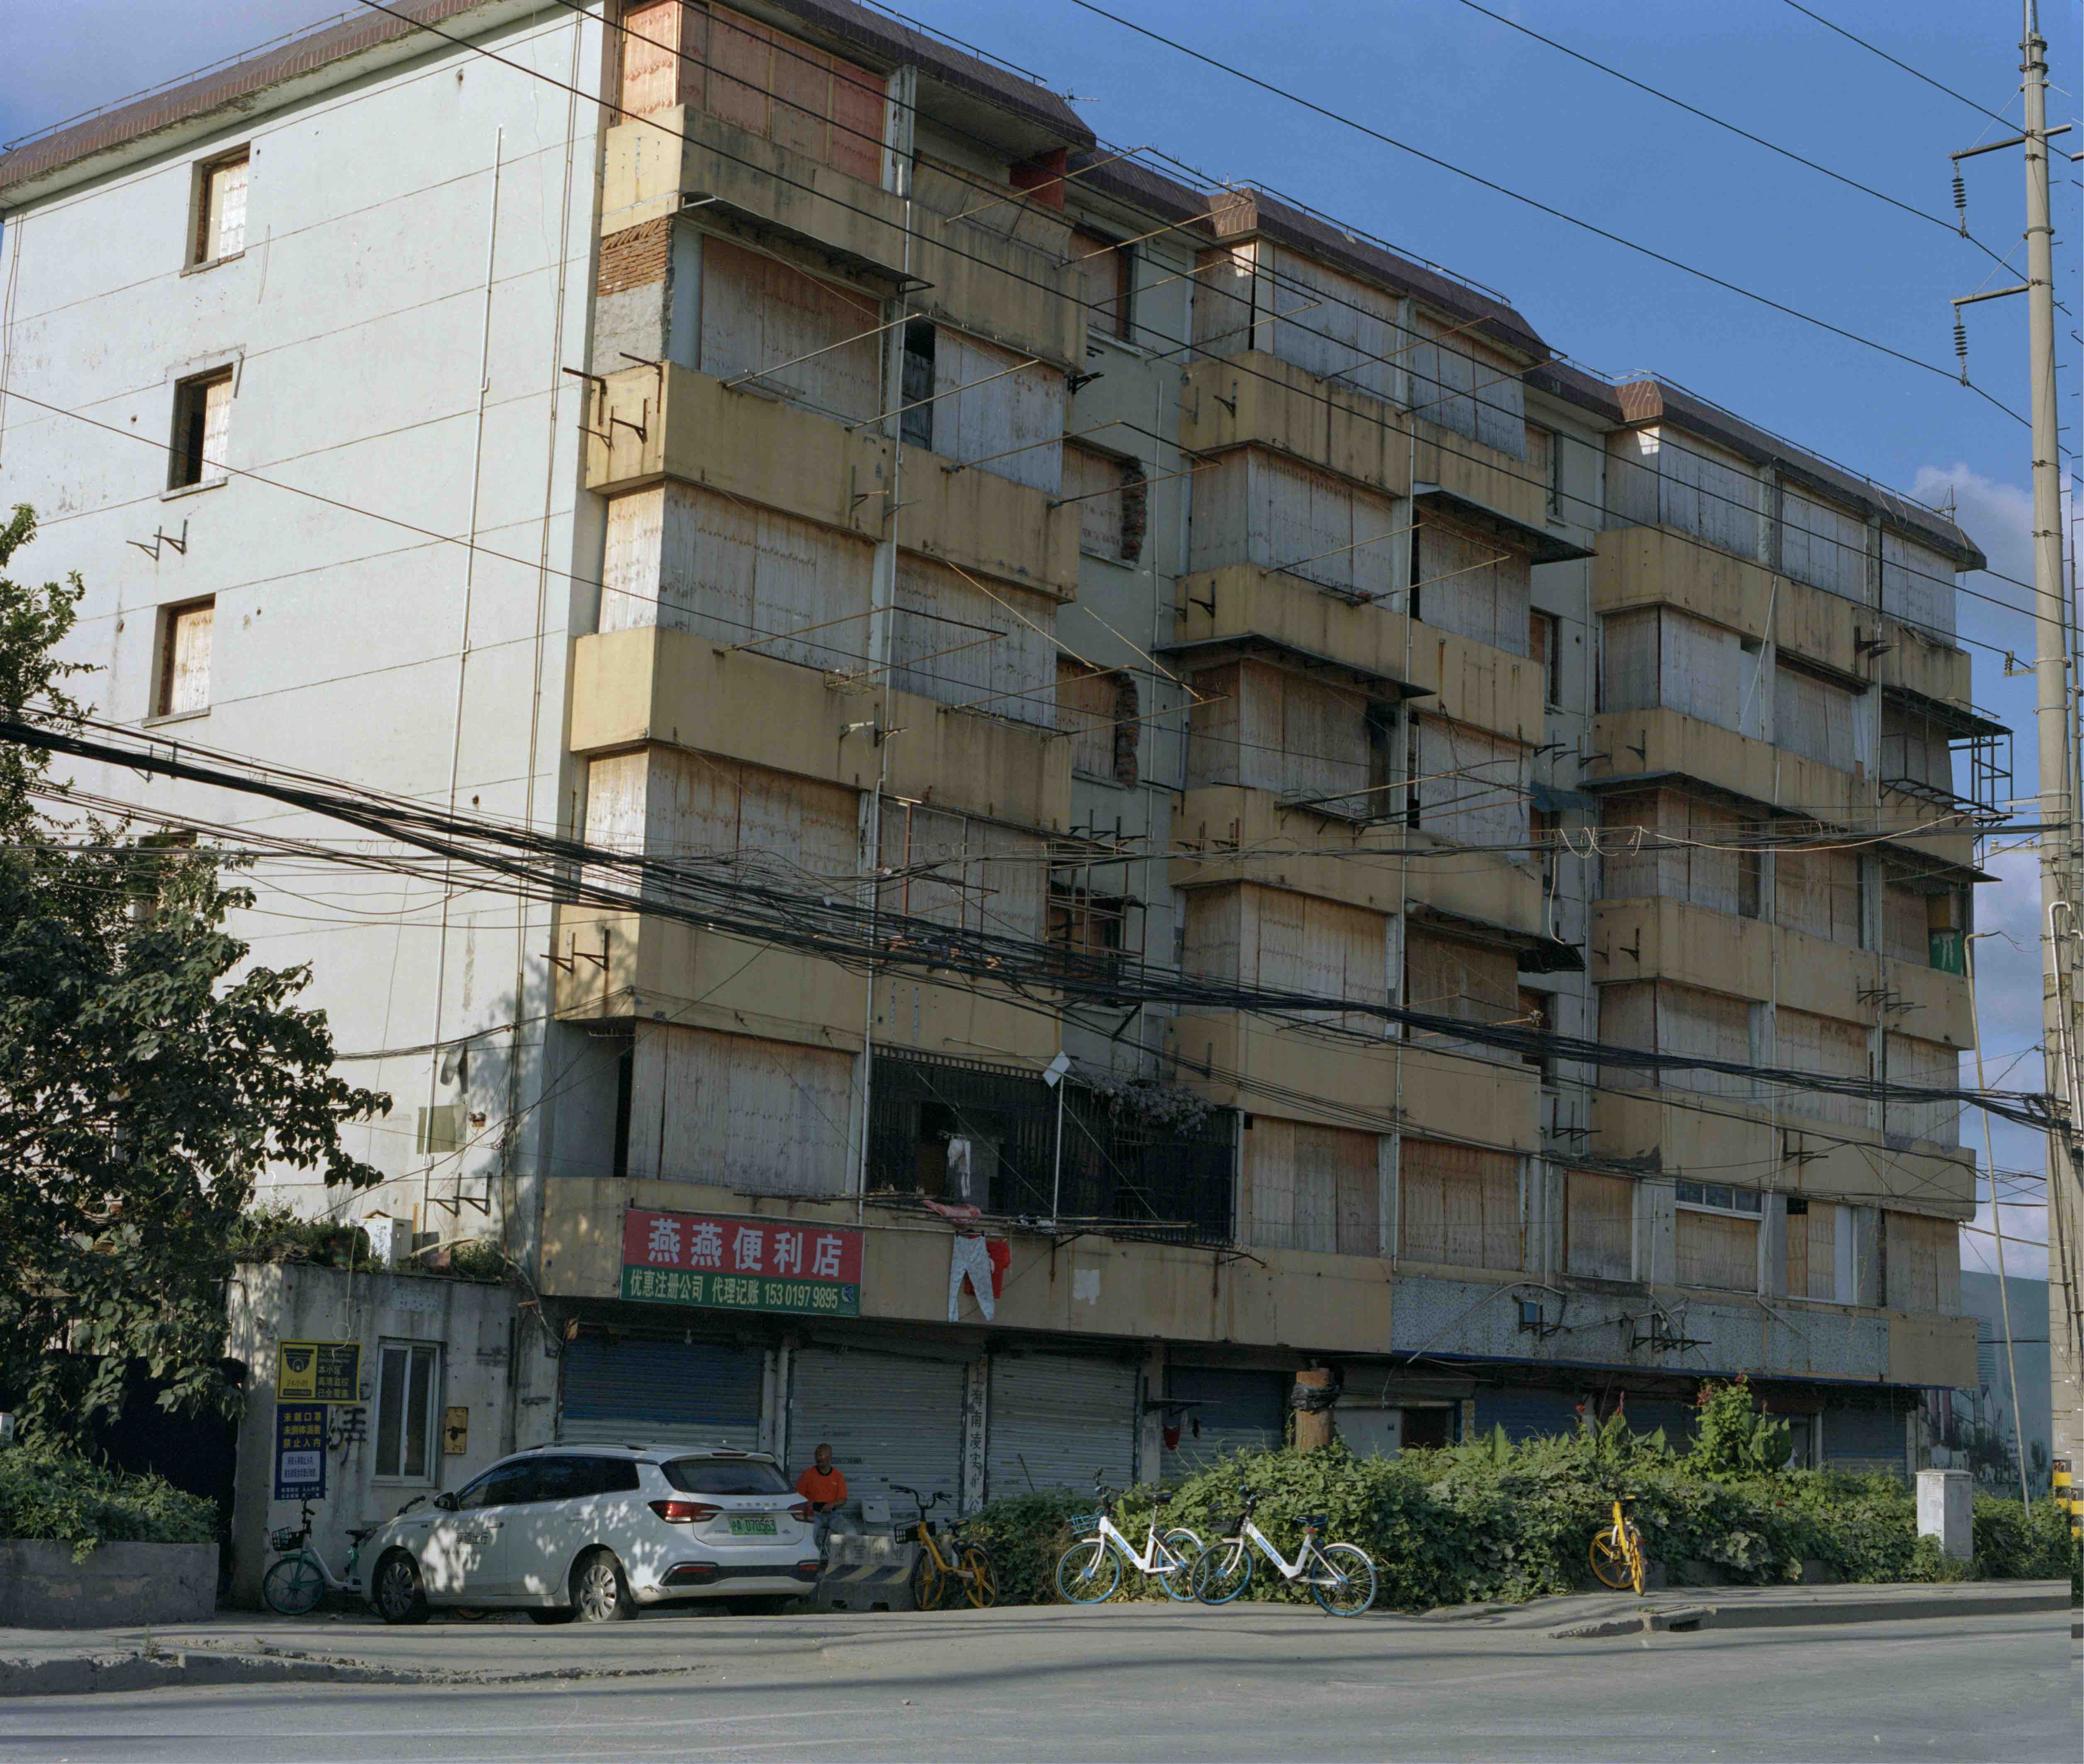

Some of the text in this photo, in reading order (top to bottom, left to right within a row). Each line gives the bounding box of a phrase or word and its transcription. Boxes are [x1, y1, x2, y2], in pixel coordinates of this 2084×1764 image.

[648, 1218, 843, 1277] 燕燕便利店
[630, 1268, 838, 1309] 优惠注册公司 代理记账 153 0197 9895
[283, 1438, 321, 1448] 禁止入内
